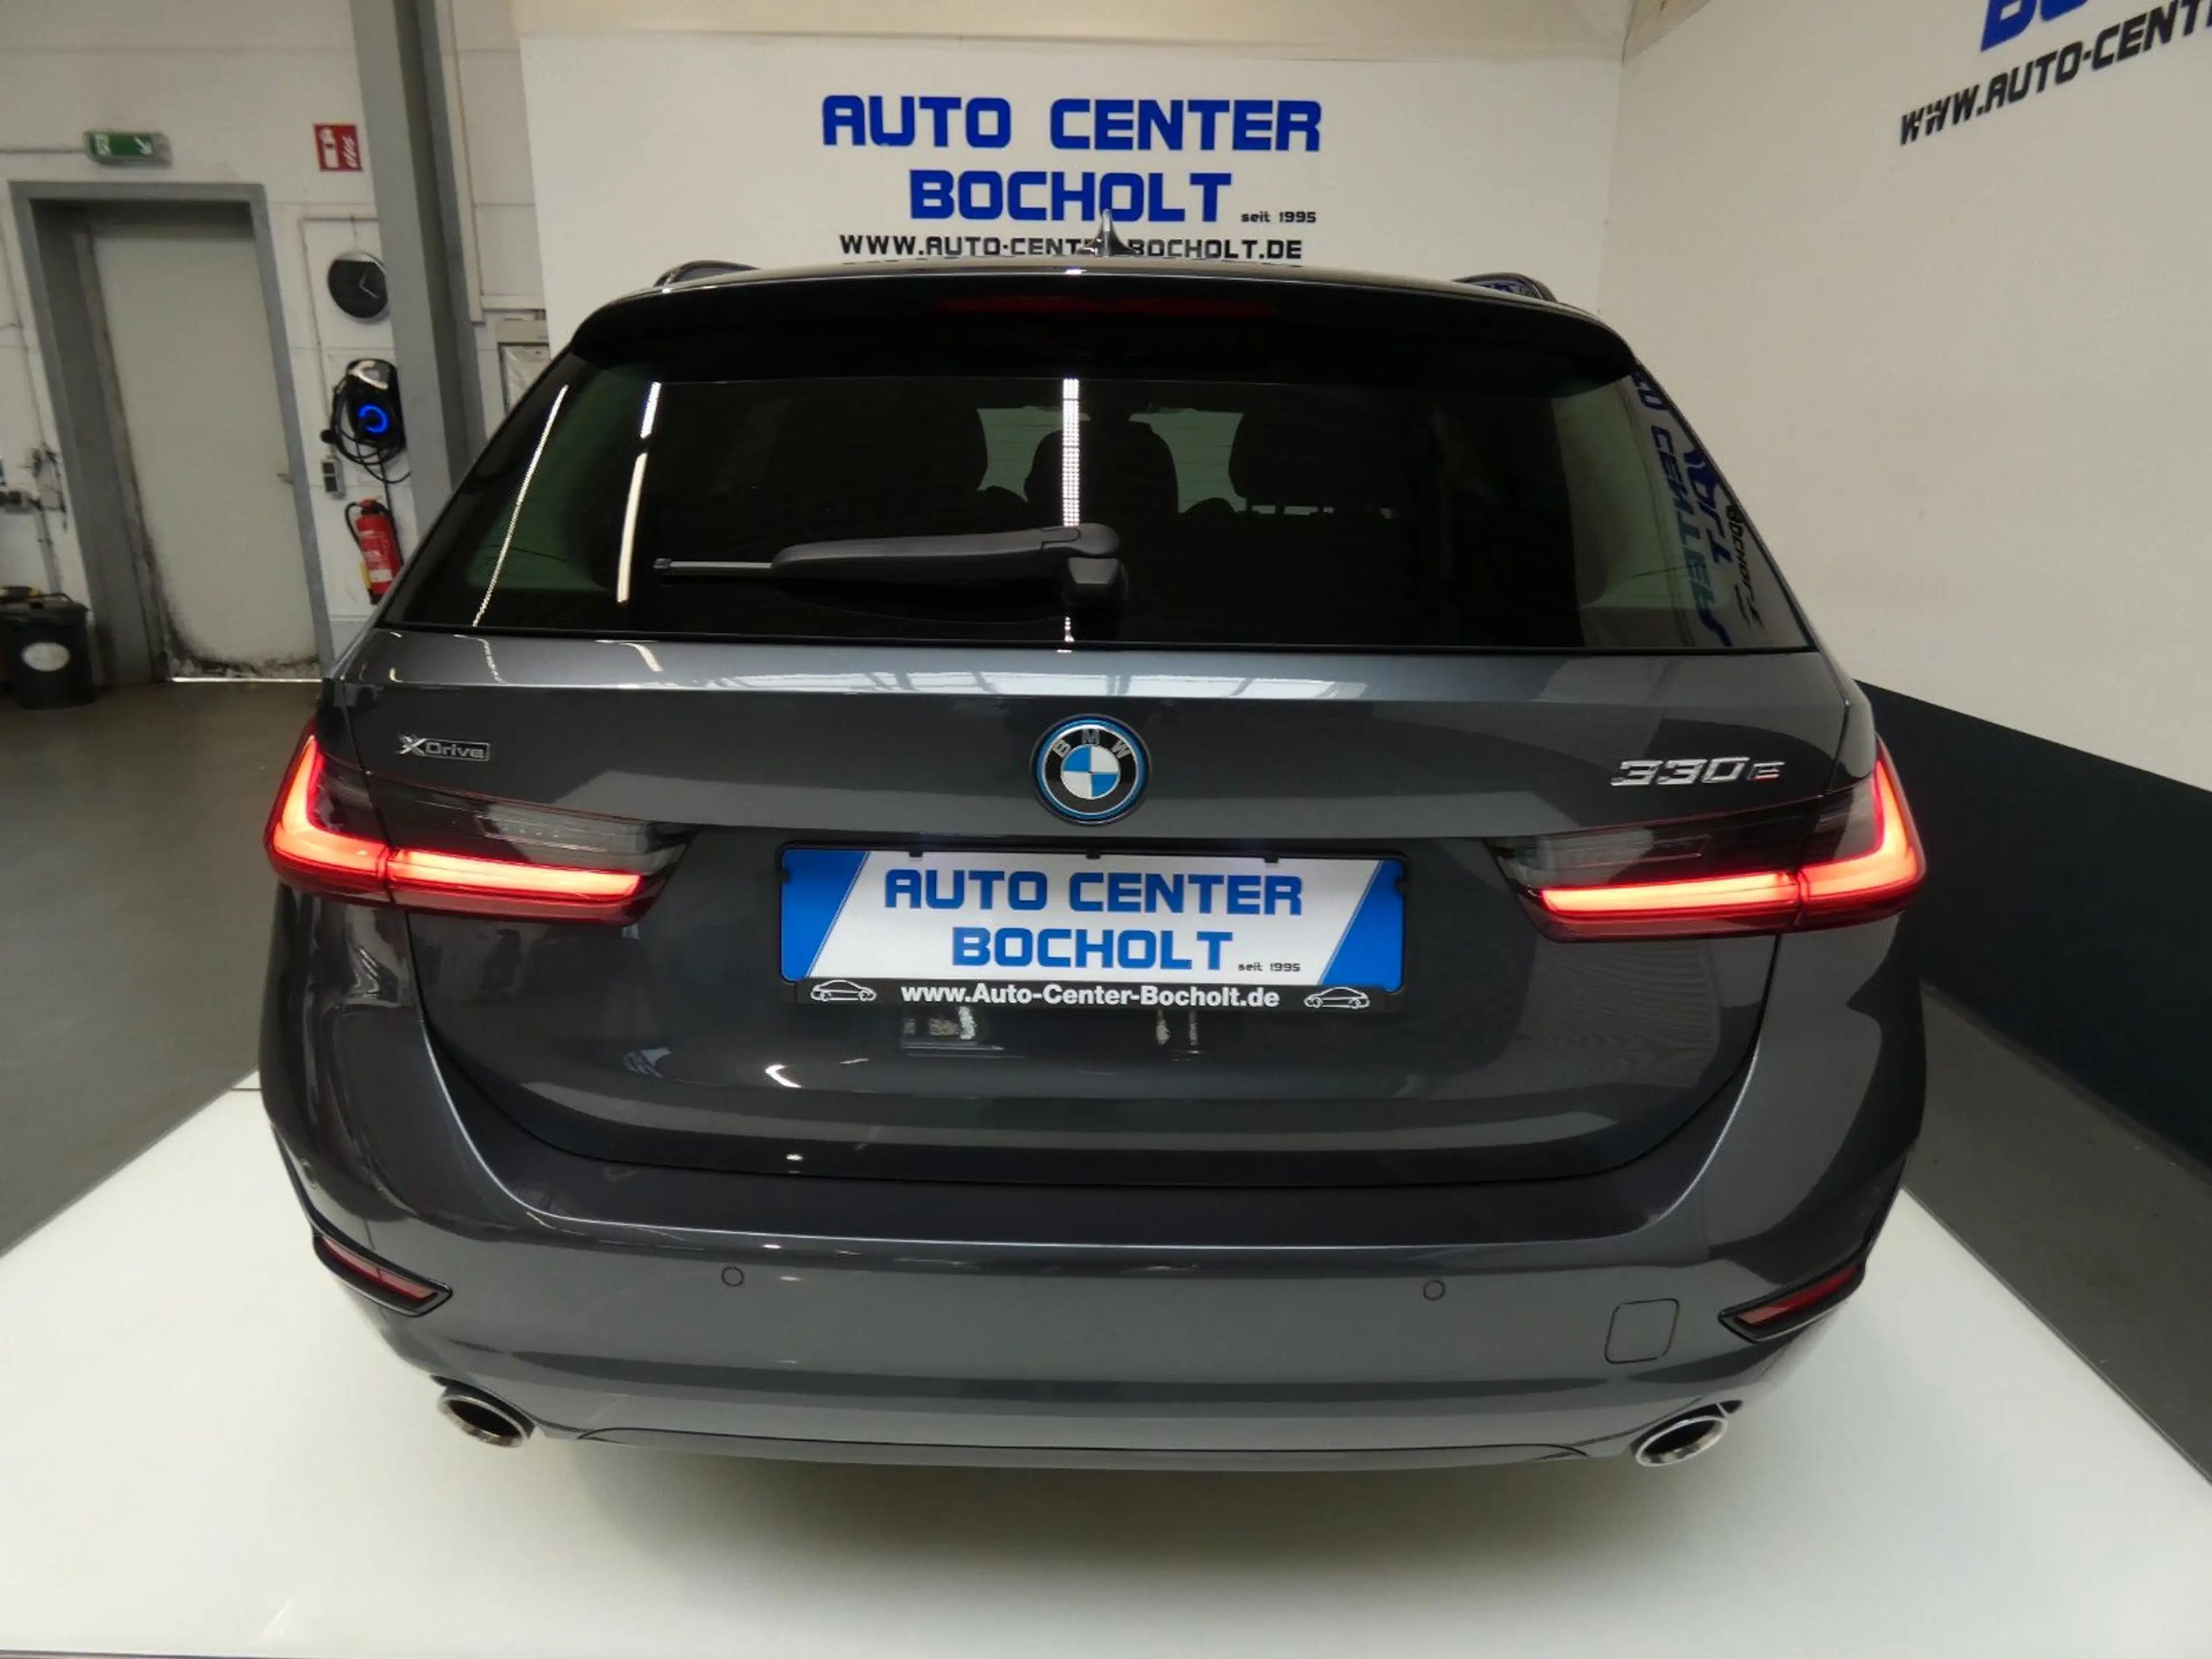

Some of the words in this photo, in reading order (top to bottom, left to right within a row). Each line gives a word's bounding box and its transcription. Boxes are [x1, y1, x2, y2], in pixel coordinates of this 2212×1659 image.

[1900, 0, 2212, 146] WWW.AUTO-CENT
[823, 95, 1012, 149] AUTO
[1051, 99, 1321, 151] CENTER
[910, 169, 1233, 222] BOCHOLT
[1241, 211, 1271, 223] seit
[1279, 211, 1316, 224] 1995
[1052, 728, 1131, 759] BMW
[885, 868, 1047, 911] AUTO
[1070, 873, 1303, 916] CENTER
[952, 926, 1234, 971] BOCHOLT
[1238, 963, 1263, 971] seit
[1270, 963, 1301, 972] 1995
[901, 983, 1281, 1008] www.Auto-Center-Bocholt.de
